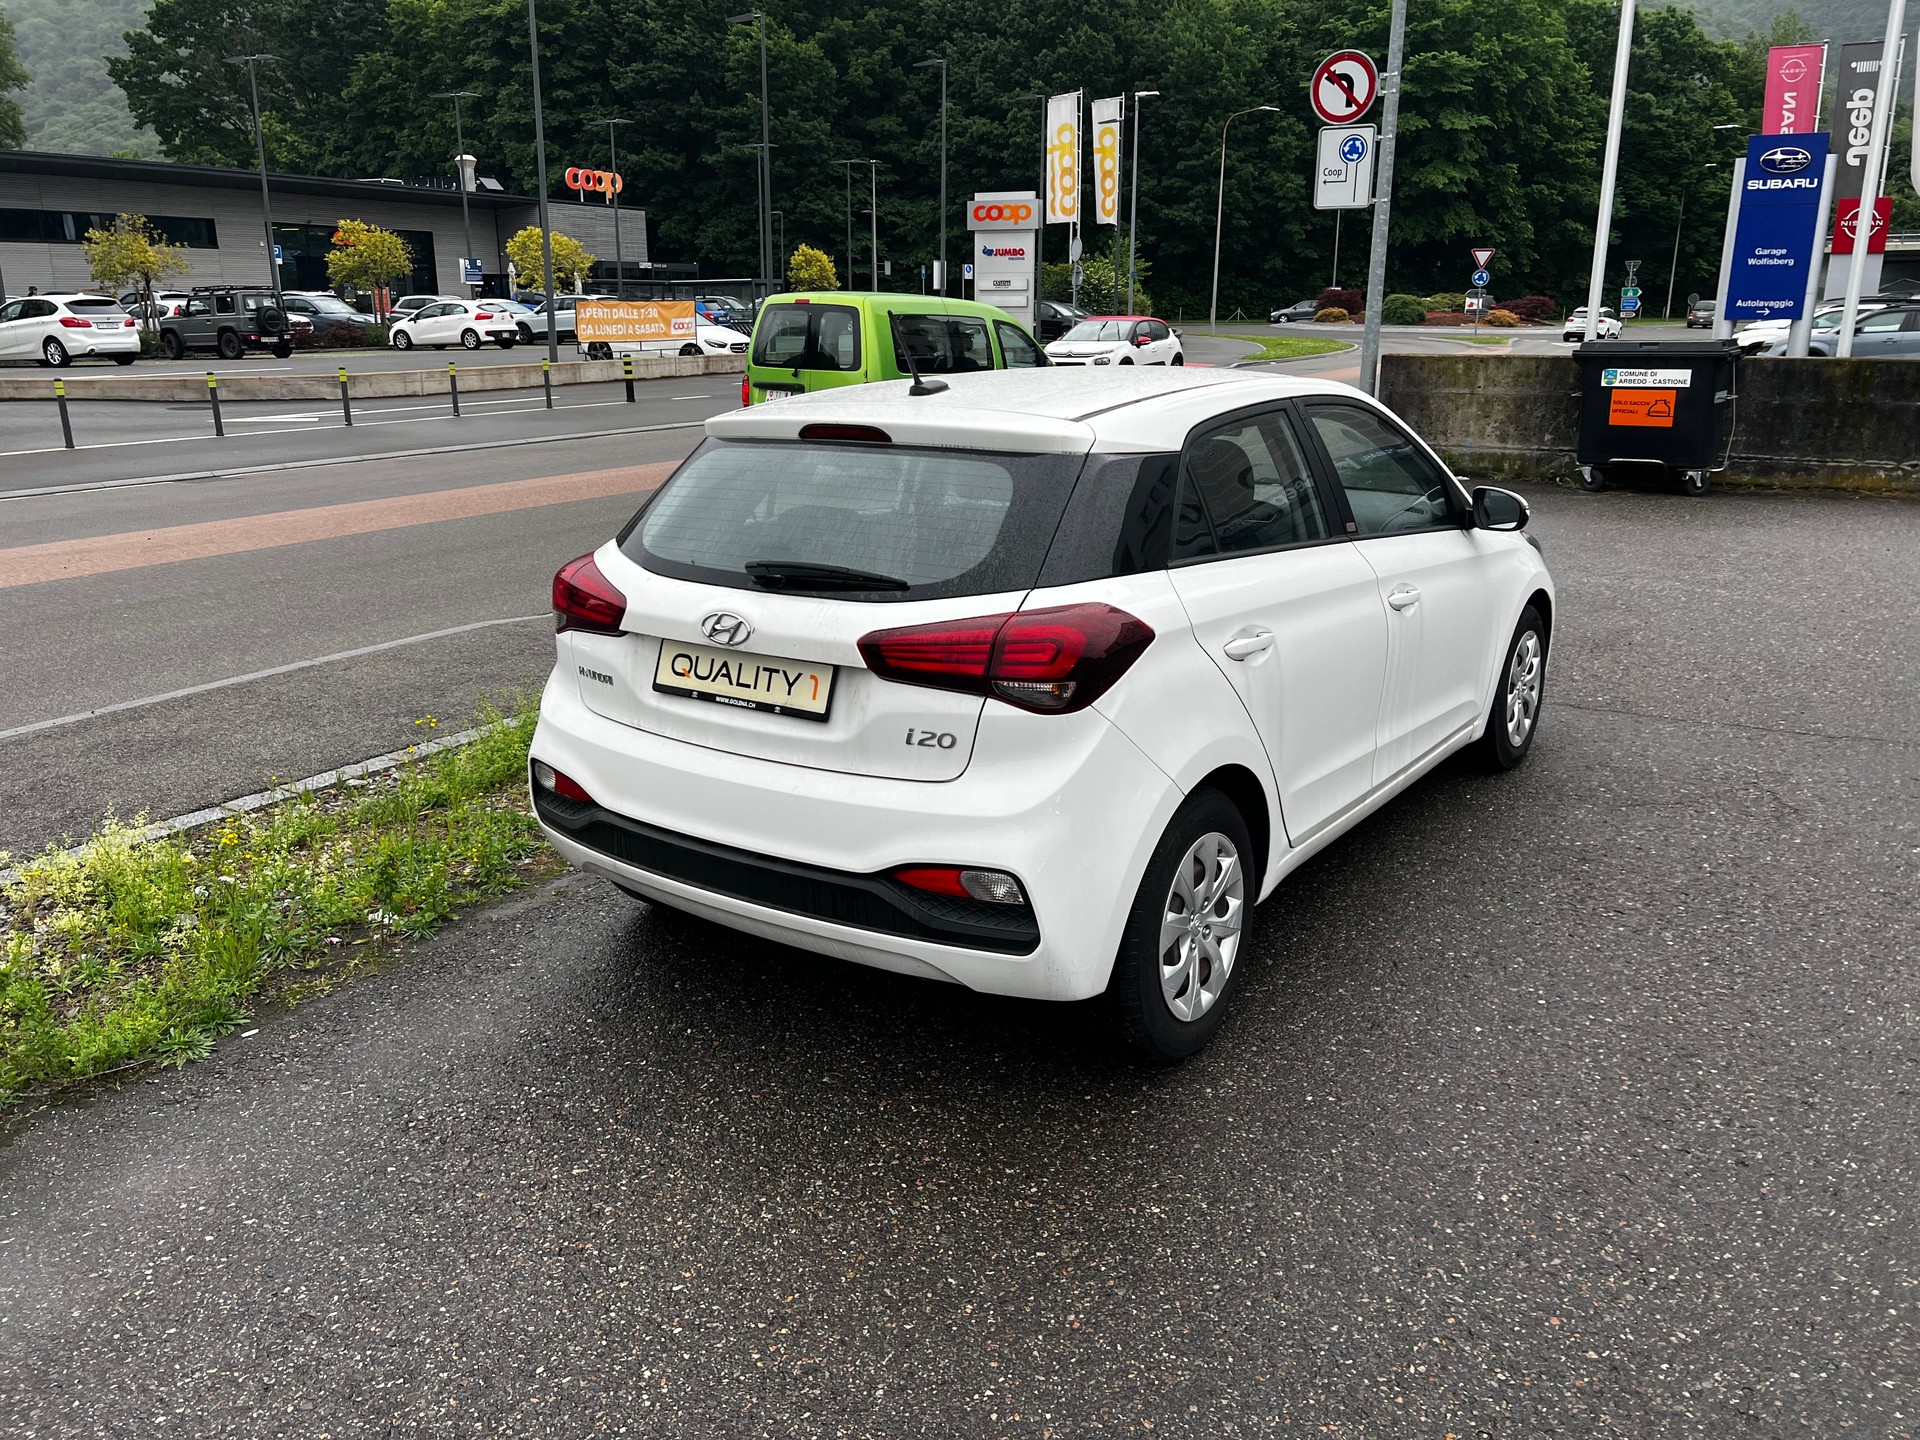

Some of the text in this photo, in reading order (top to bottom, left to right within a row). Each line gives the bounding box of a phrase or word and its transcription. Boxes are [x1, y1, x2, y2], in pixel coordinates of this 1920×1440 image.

[1323, 167, 1342, 178] Coop
[565, 167, 623, 199] coop
[1747, 178, 1818, 190] SUBARU
[973, 204, 1032, 225] coop
[993, 248, 1025, 256] JUMBO
[1755, 248, 1787, 256] Garage
[1748, 258, 1794, 266] Wolfisberg
[1736, 300, 1793, 308] Autolavaggio
[579, 308, 611, 319] APERTI
[613, 308, 639, 318] DALLE
[580, 322, 665, 335] DA LUNEDÌ A SABATO
[671, 653, 819, 700] QUALITY 1
[905, 728, 957, 749] i20
